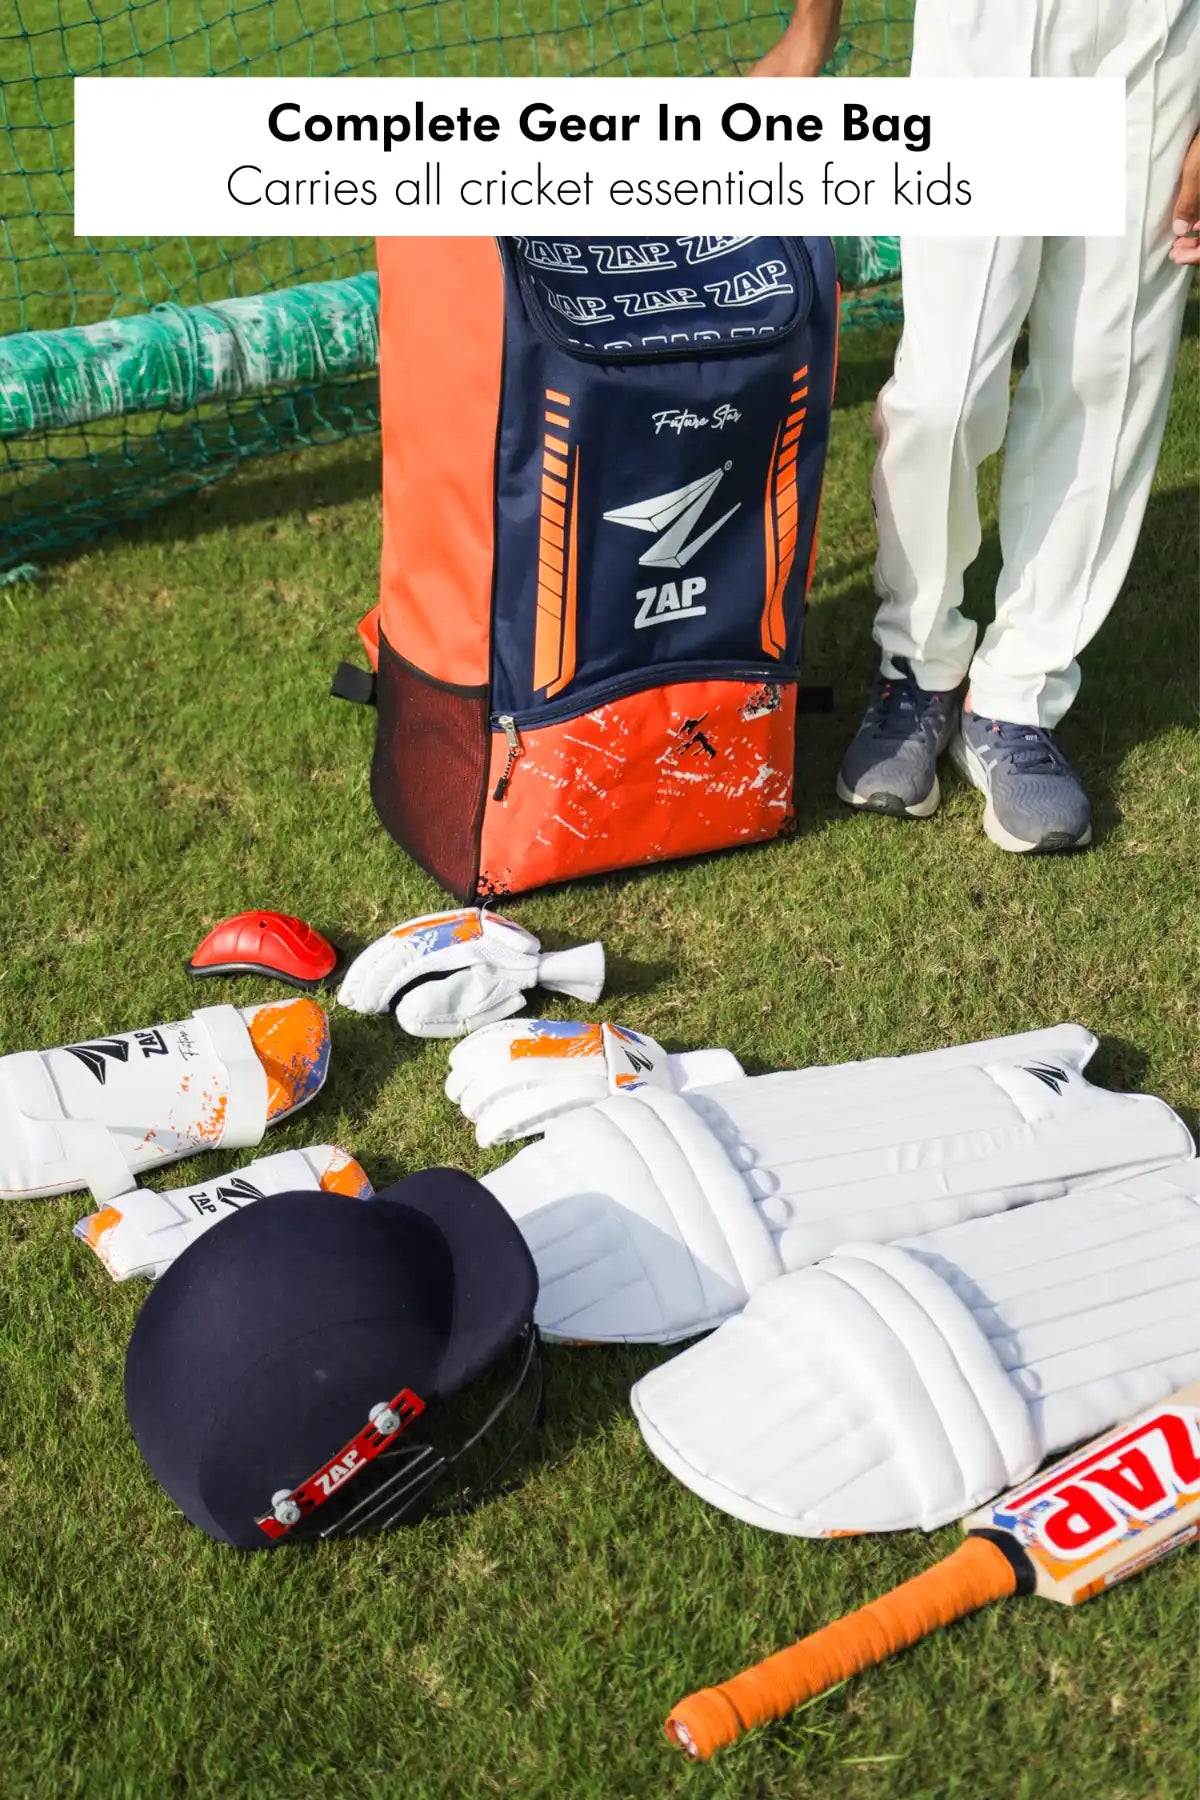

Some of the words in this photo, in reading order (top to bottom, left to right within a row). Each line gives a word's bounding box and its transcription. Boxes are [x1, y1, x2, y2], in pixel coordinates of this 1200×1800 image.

[588, 243, 677, 274] ZAP
[676, 236, 760, 265] ZA
[614, 287, 706, 317] ZAP
[704, 260, 793, 307] ZAP
[651, 408, 709, 435] Future
[711, 403, 742, 430] Star
[634, 576, 707, 630] ZAP
[133, 1029, 169, 1058] ZAP
[188, 1191, 217, 1216] ZAP
[314, 1449, 367, 1496] ZAP
[1004, 1413, 1200, 1550] ZAP
